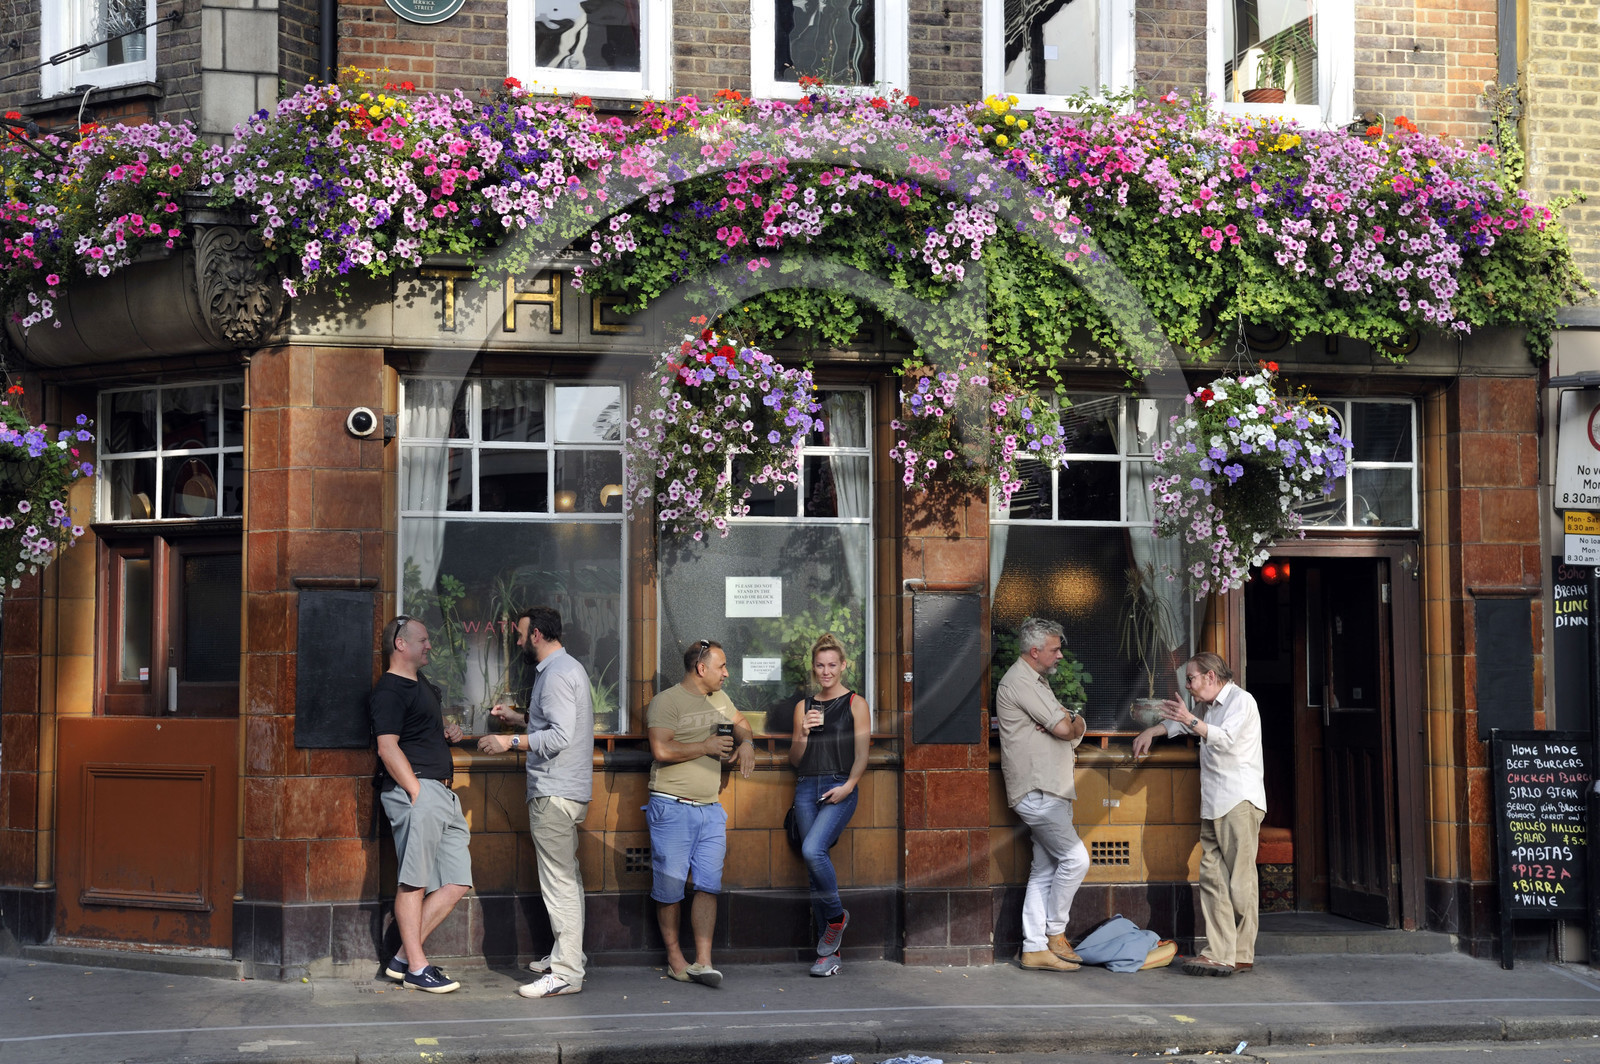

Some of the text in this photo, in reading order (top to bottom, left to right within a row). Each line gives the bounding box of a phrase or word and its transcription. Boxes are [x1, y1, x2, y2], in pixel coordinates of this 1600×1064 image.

[418, 265, 645, 335] THE
[1577, 465, 1591, 476] No
[1567, 515, 1582, 523] Mon
[1586, 516, 1599, 524] Sat
[1511, 744, 1579, 756] HOME MADE
[1506, 758, 1584, 770] BEEF BURGERS
[1507, 772, 1555, 784] CHICKEN
[1546, 785, 1579, 799] STEAK
[1509, 820, 1547, 833] GRILLED
[1514, 832, 1547, 845] SALAD
